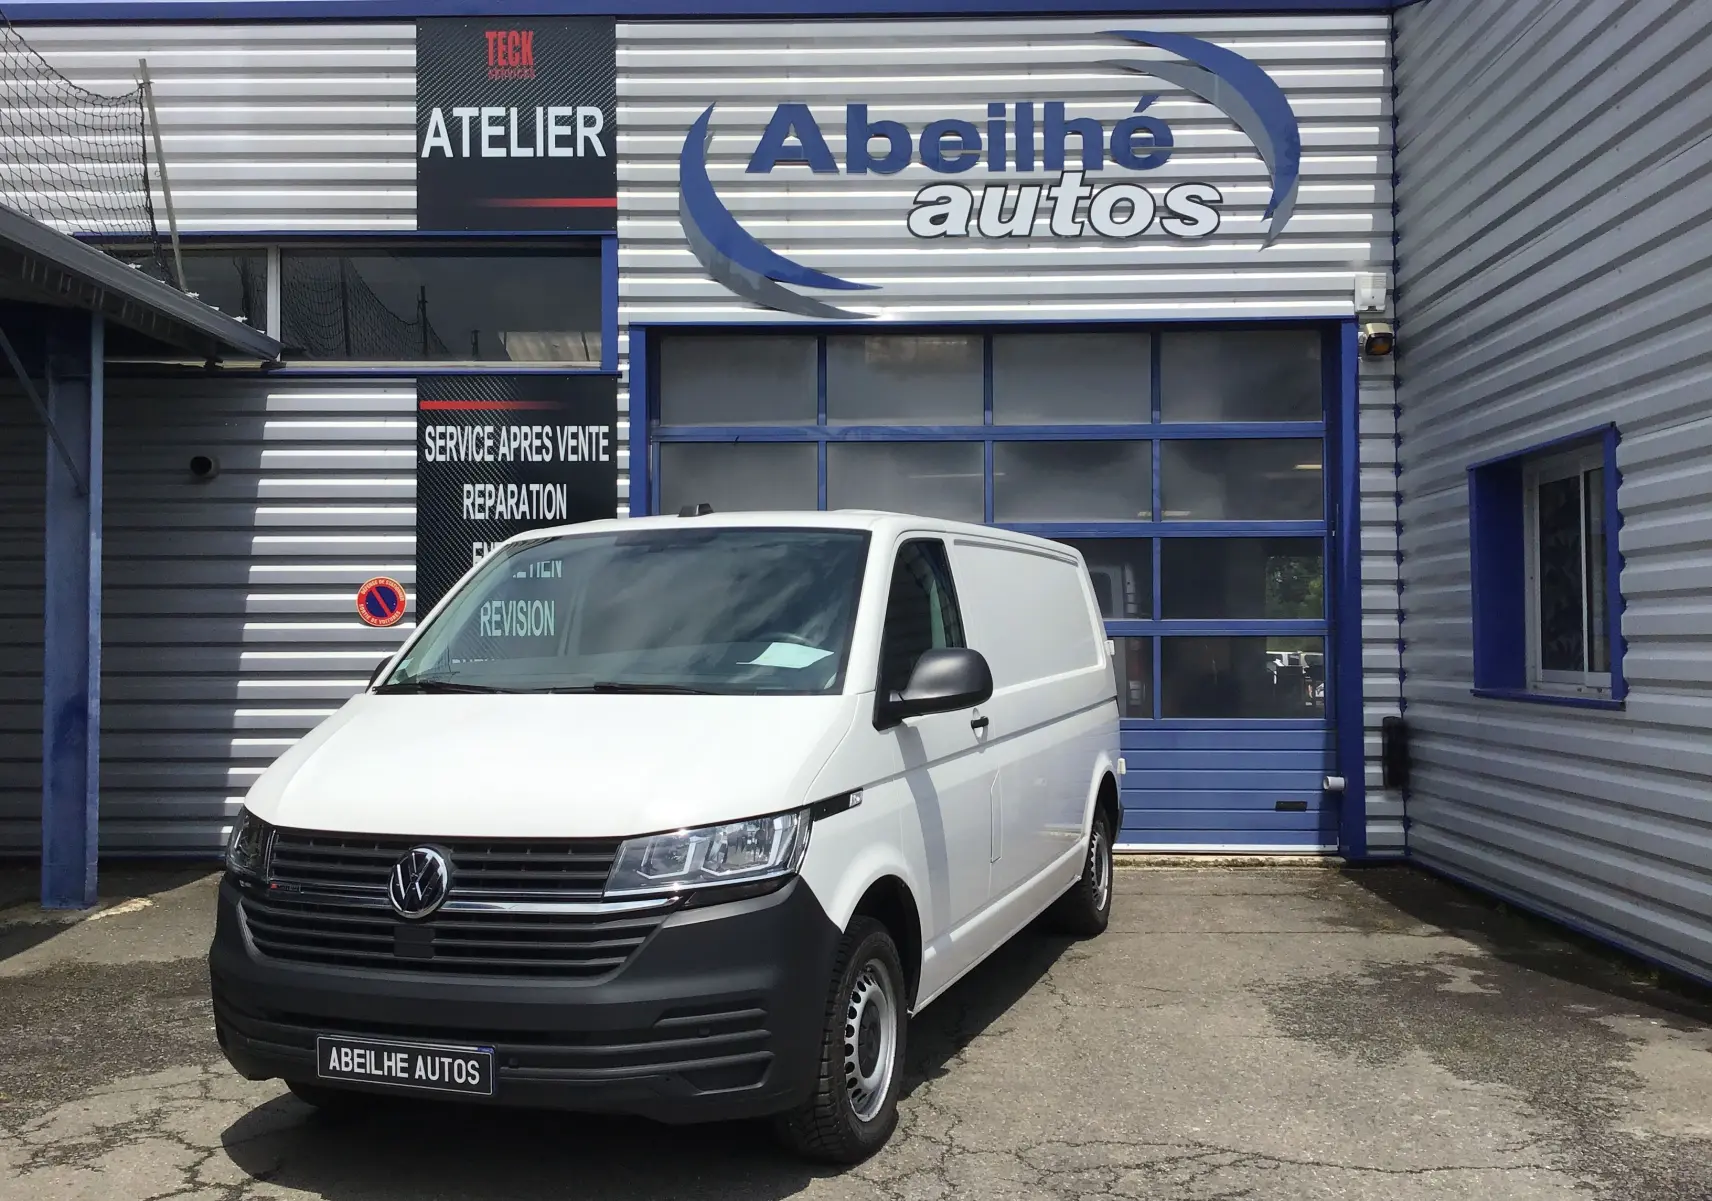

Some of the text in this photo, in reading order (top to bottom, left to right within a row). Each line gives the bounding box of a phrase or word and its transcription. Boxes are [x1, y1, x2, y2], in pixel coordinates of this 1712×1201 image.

[485, 30, 534, 66] TECK
[421, 107, 607, 158] ATELIER
[745, 95, 1175, 174] Abeilhé
[907, 170, 1223, 239] autos
[424, 425, 610, 462] SERVICE APRES VENTE
[463, 483, 567, 520] REPARATION
[480, 600, 555, 637] REVISION
[329, 1046, 480, 1085] ABEILHE AUTOS
